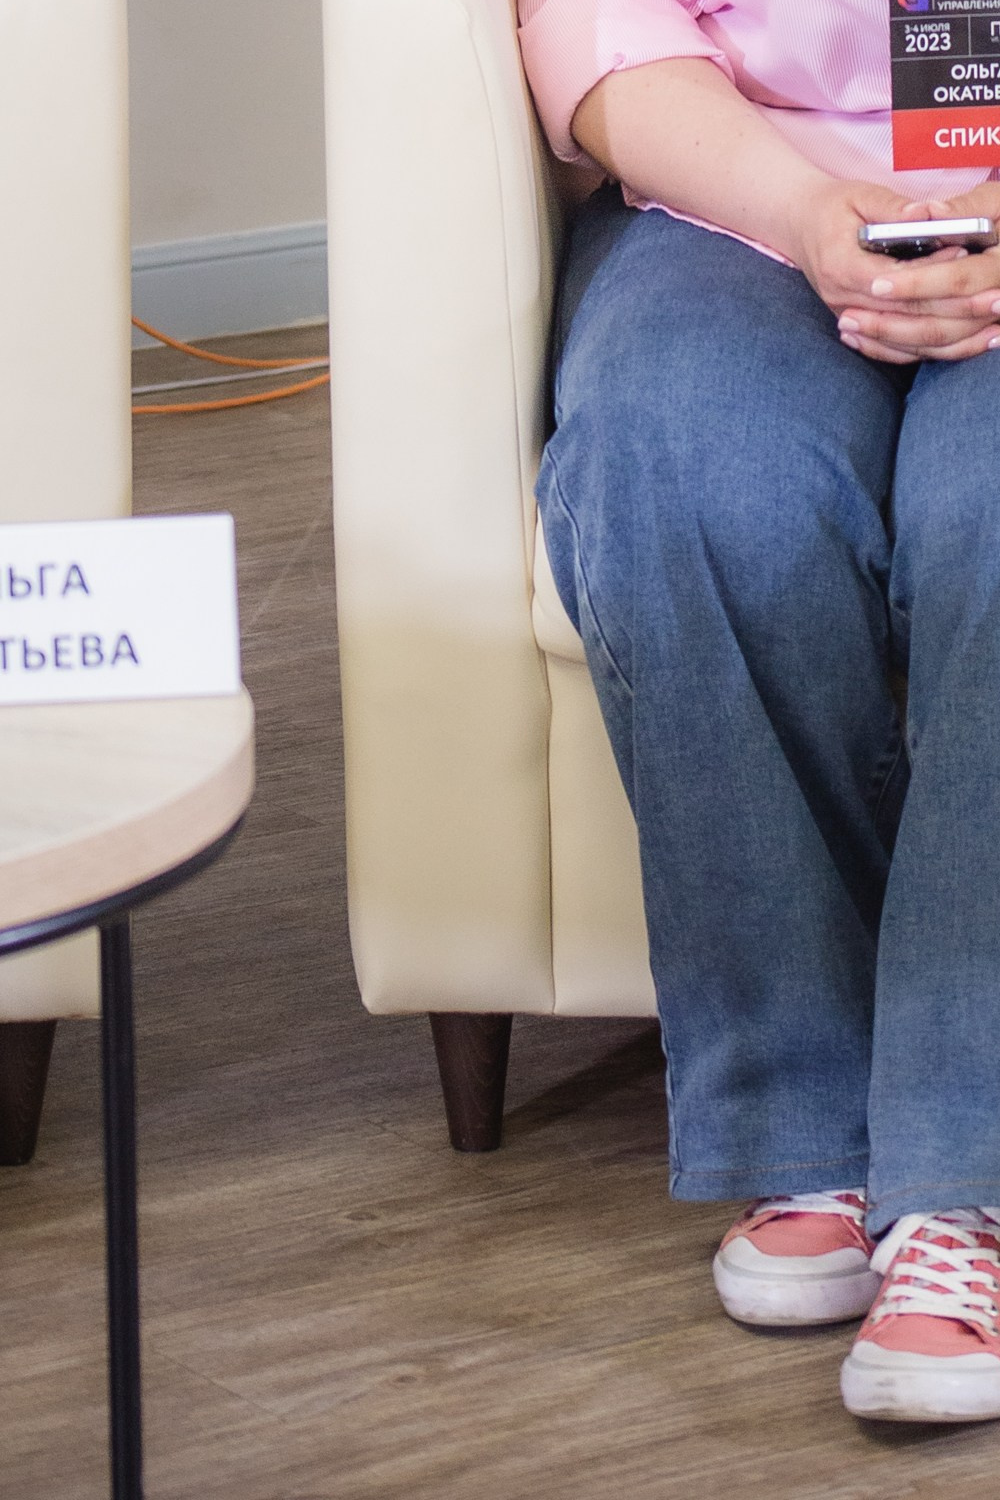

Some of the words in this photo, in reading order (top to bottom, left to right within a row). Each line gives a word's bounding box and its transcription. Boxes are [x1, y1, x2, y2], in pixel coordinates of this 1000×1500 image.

[904, 24, 919, 34] 3-4
[920, 22, 951, 33] ИЮЛЯ
[905, 32, 952, 53] 2023
[0, 563, 90, 599] ЬГА
[0, 633, 140, 671] ТЬЕВА
